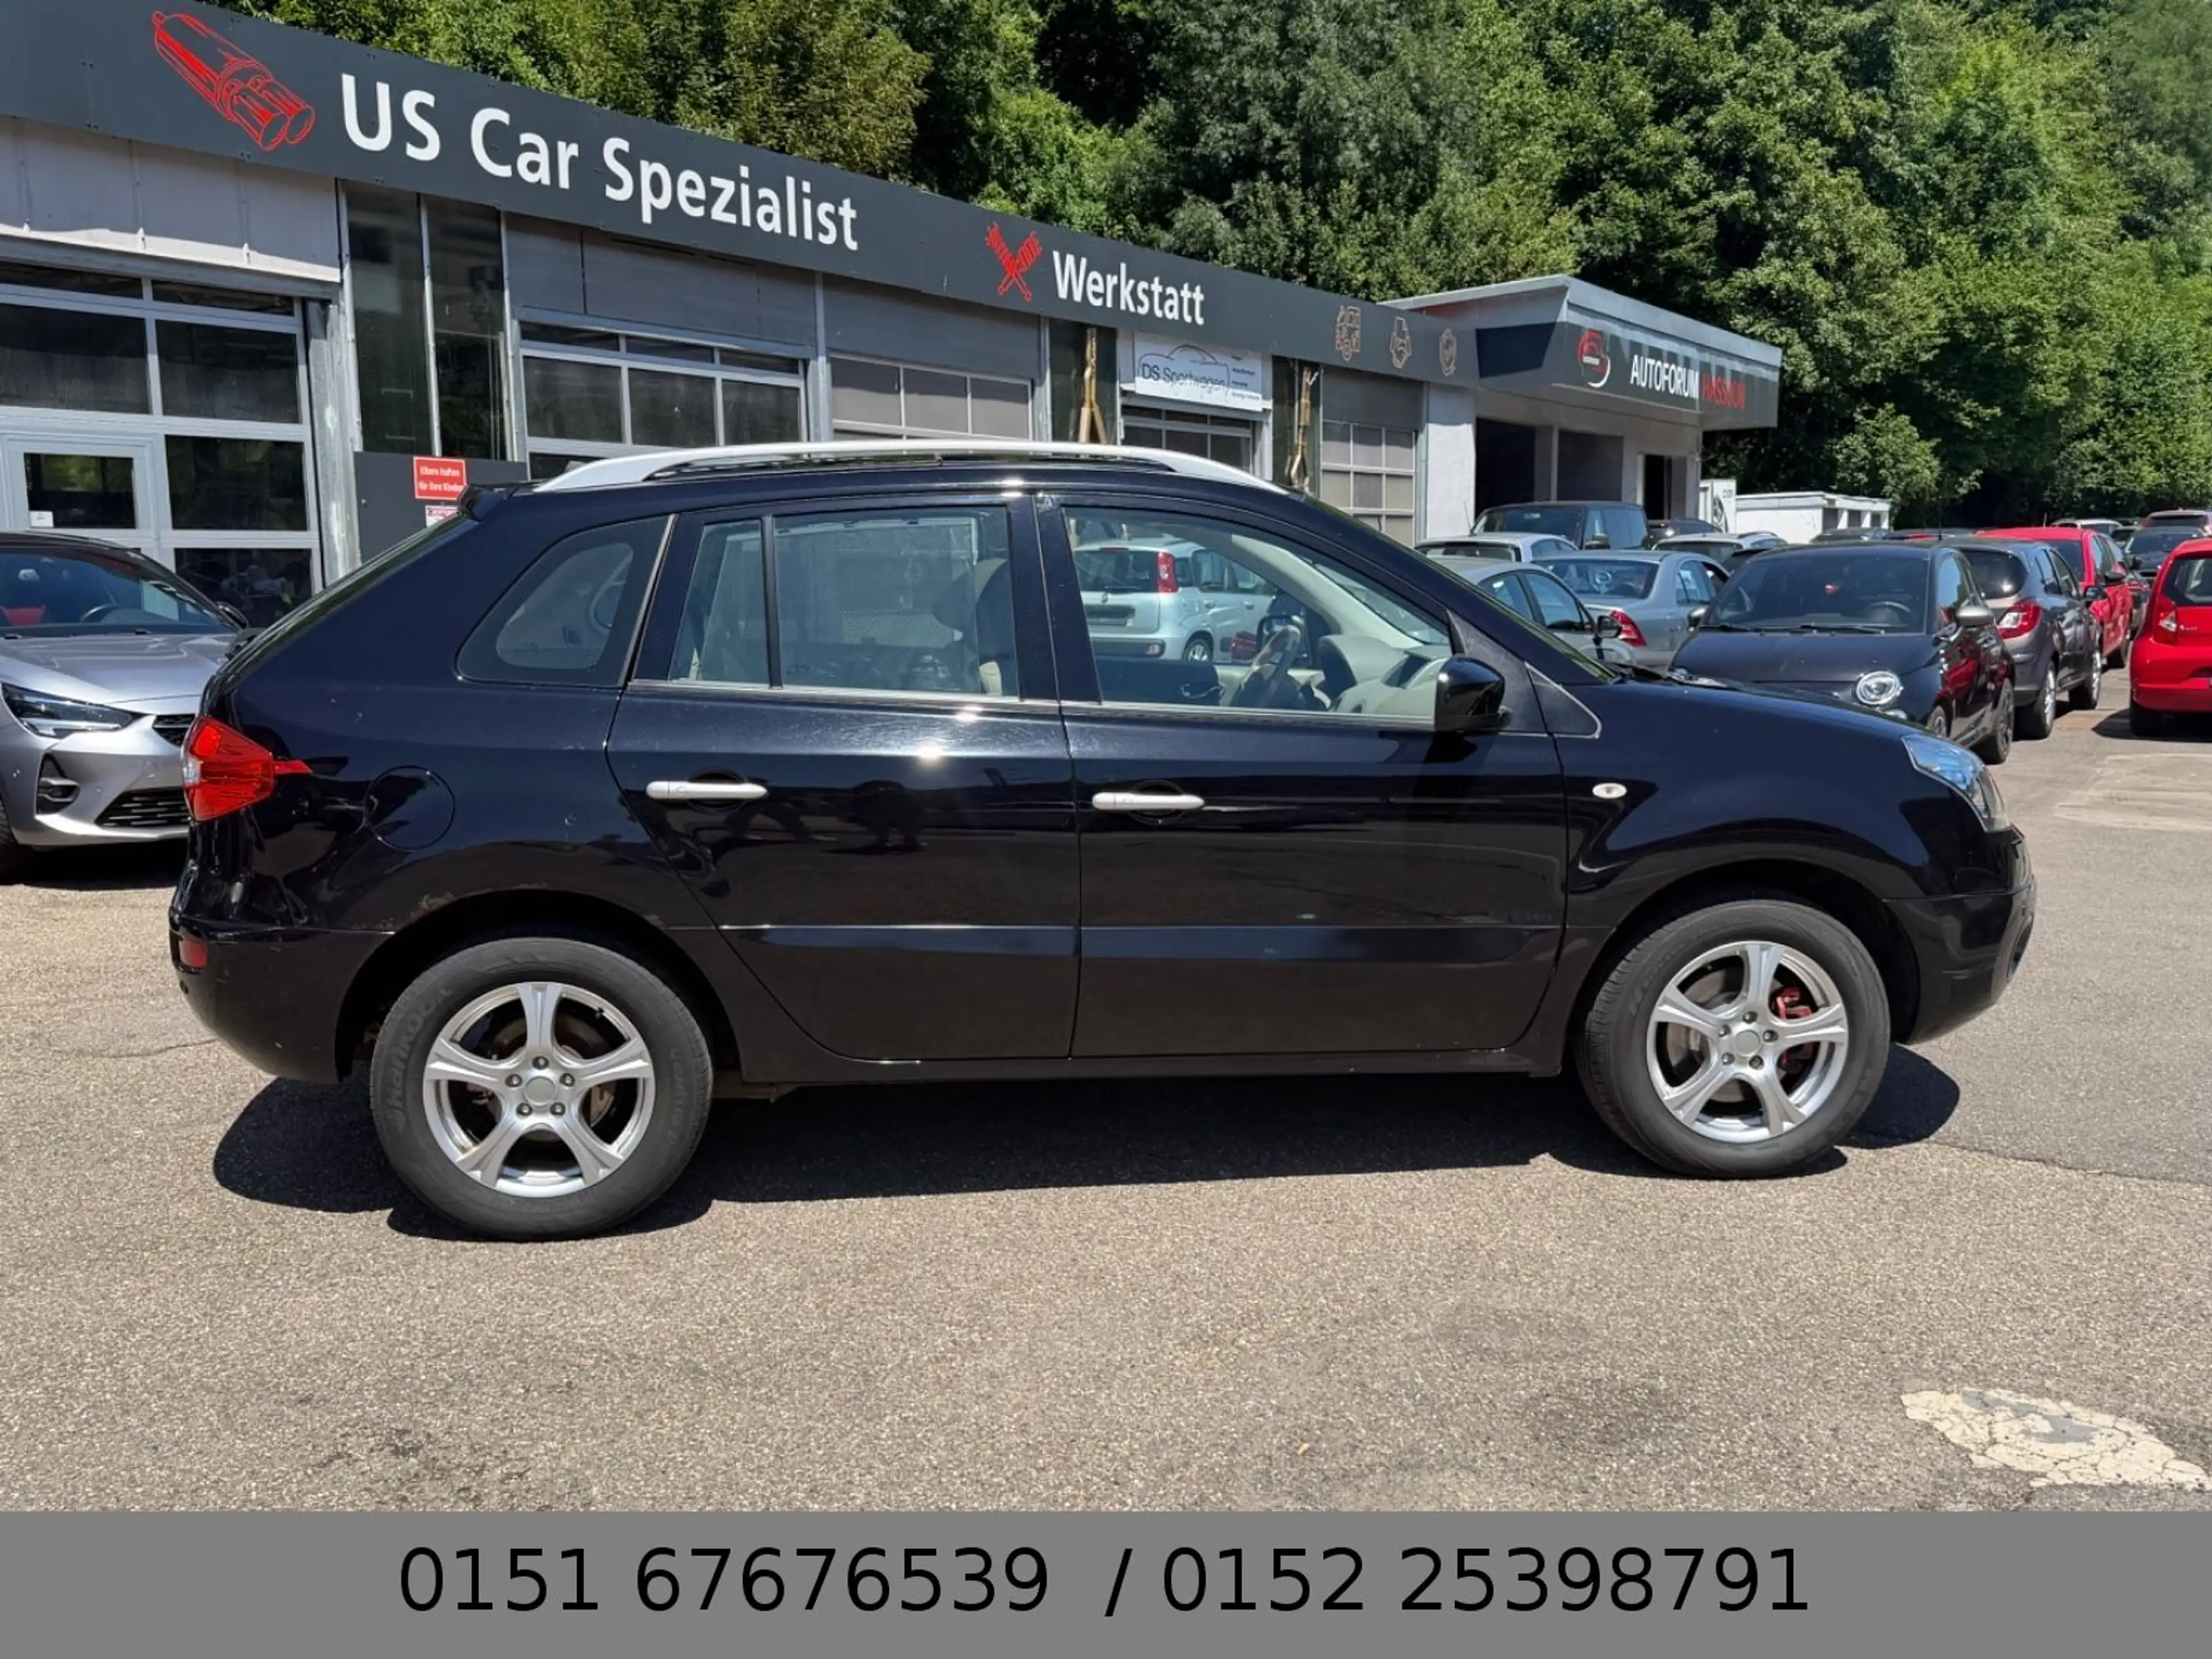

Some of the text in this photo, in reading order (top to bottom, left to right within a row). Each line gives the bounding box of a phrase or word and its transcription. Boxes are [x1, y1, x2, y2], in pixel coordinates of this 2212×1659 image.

[342, 73, 858, 251] US Car Spezialist
[1052, 250, 1205, 326] Werkstatt
[1142, 362, 1160, 381] DS
[1630, 354, 1699, 399] AUTOFORUM
